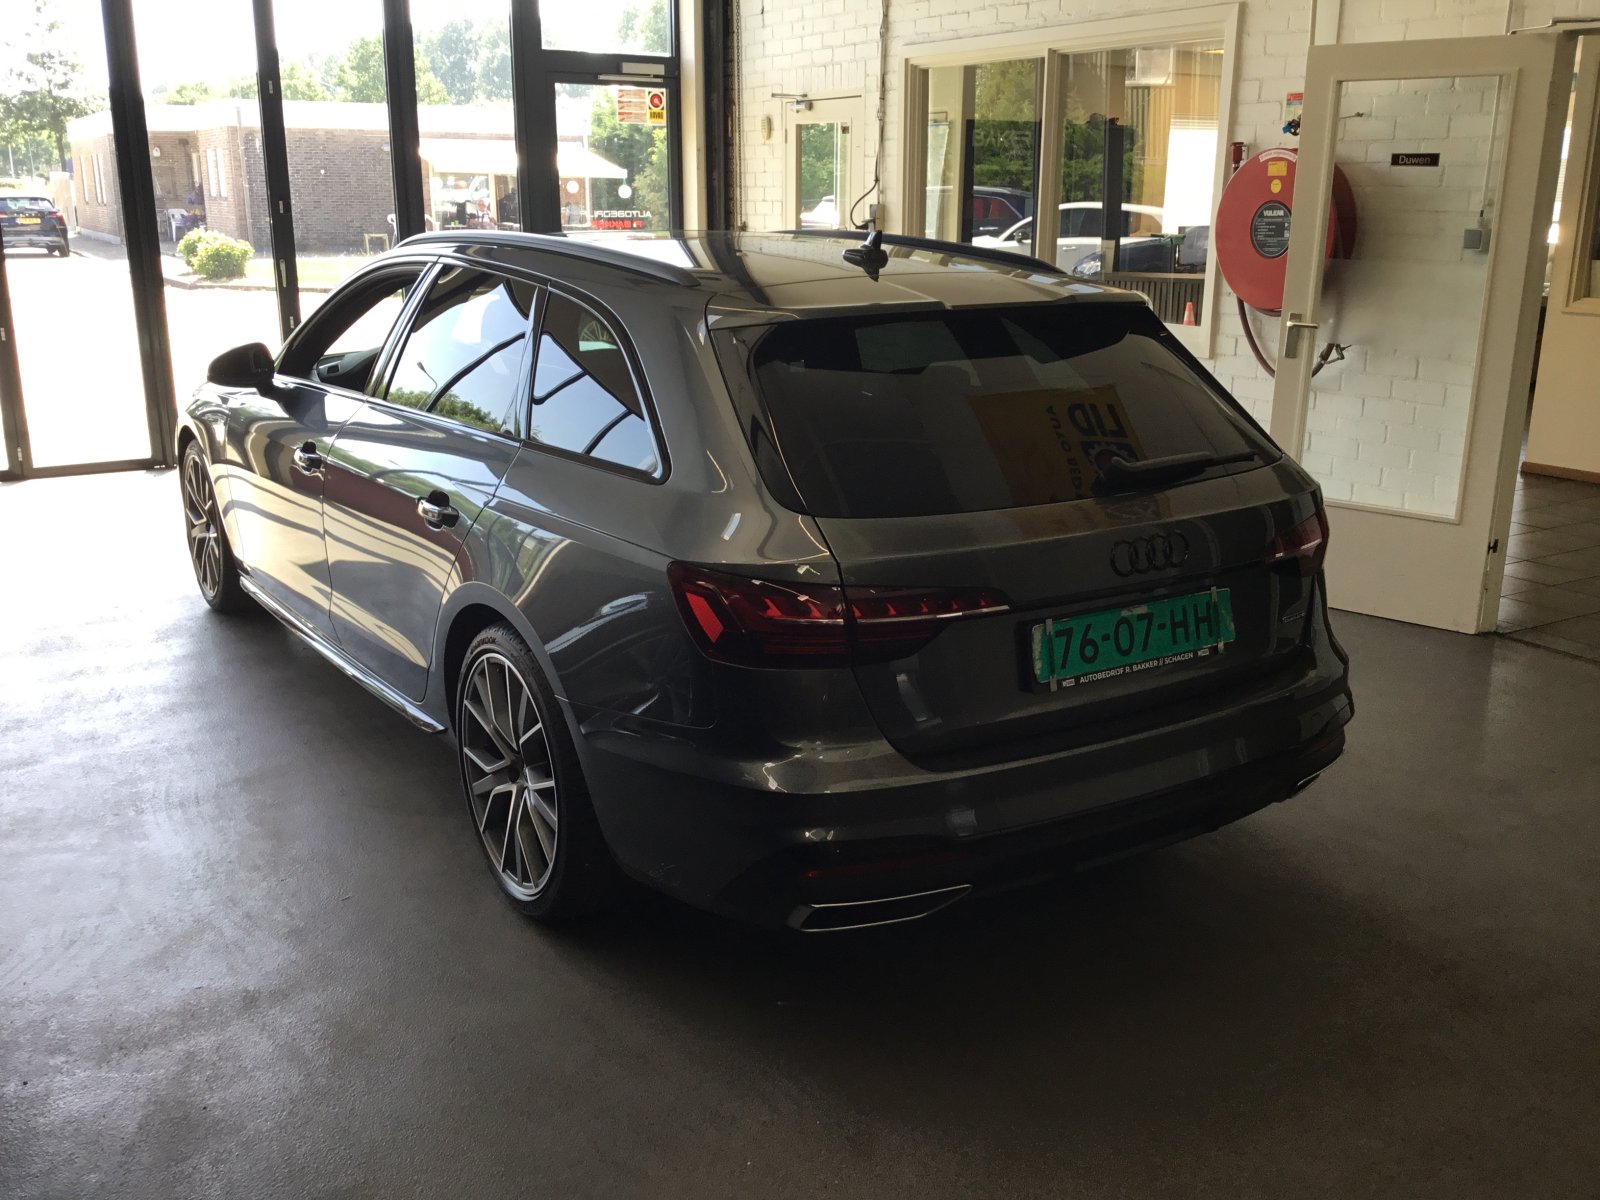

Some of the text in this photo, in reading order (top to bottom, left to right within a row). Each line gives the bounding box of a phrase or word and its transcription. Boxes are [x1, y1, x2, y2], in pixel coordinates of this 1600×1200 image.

[1398, 155, 1431, 165] Duwen
[1054, 600, 1213, 670] 76-07-HH
[1079, 665, 1125, 684] AUTOBEDRIJF
[1125, 663, 1132, 673] R.
[1132, 660, 1159, 672] BAKKER
[1164, 652, 1194, 665] SCHAGEN
